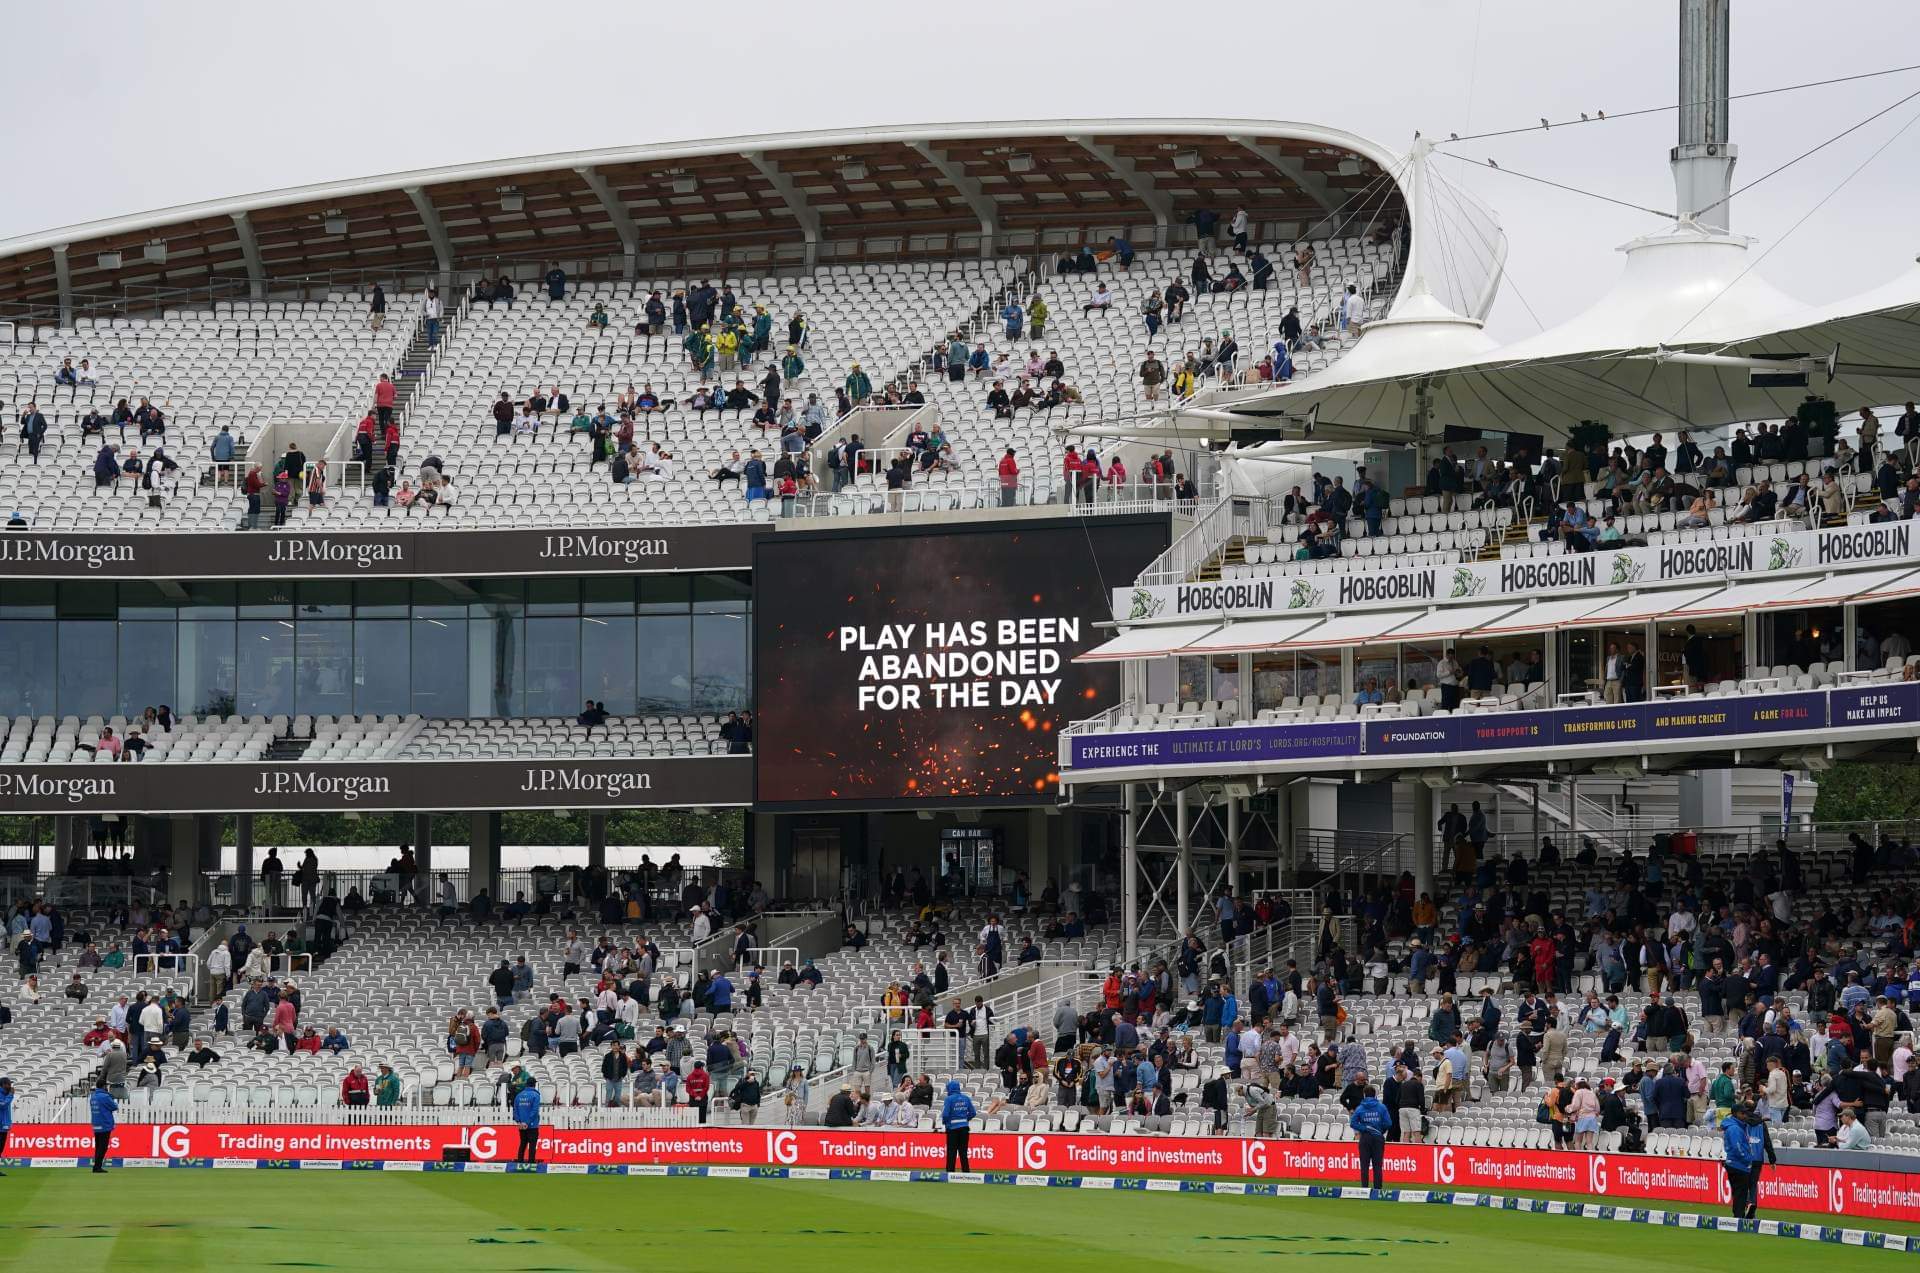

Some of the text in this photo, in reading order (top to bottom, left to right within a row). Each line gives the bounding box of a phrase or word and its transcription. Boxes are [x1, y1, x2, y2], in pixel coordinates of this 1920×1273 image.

[268, 539, 404, 568] J.P.Morgan
[540, 536, 669, 564] J.P.Morgan
[1818, 524, 1910, 564] HOBGOBLIN
[1660, 541, 1753, 579] HOBGOBLIN
[1339, 570, 1435, 604] HOBGOBLIN
[1501, 556, 1596, 593] HOBGOBLIN
[1177, 581, 1273, 614] HOBGOBLIN
[840, 617, 1080, 651] PLAY HAS BEEN
[858, 648, 1061, 682] ABANDONED
[858, 679, 1062, 711] FOR THE DAY
[1860, 695, 1888, 706] HELP US
[1563, 719, 1637, 733] TRANSFORMING LIVES
[1656, 713, 1727, 727] AND MAKING CRICKET
[1754, 708, 1808, 720] A GAME FOR ALL
[1847, 707, 1902, 720] MAKE AN IMPACT
[1391, 732, 1445, 742] FOUNDATION
[1476, 725, 1538, 738] YOUR SUPPORT IS
[1082, 745, 1139, 759] EXPERIENCE
[1141, 744, 1159, 756] THE
[1173, 741, 1214, 754] ULTIMATE
[1216, 740, 1227, 752] AT
[254, 772, 390, 800] J.P.Morgan
[522, 769, 652, 797] J.P.Morgan
[151, 1125, 190, 1158] IG
[217, 1133, 431, 1153] Trading and investments
[459, 1126, 498, 1160] IG
[553, 1138, 613, 1157] Trading
[617, 1137, 647, 1153] and
[651, 1137, 743, 1153] investments
[766, 1130, 798, 1165] IG
[819, 1140, 877, 1161] Trading
[879, 1142, 907, 1157] and
[1017, 1135, 1047, 1170] IG
[1066, 1144, 1223, 1165] Trading and investments
[1242, 1140, 1267, 1177] IG
[1283, 1151, 1417, 1172] Trading and inments
[1433, 1146, 1455, 1184] IG
[1468, 1157, 1576, 1181] Trading and investments
[1589, 1154, 1607, 1194] IG
[1618, 1166, 1709, 1190] Trading and investments
[1765, 1177, 1778, 1196] and
[1778, 1178, 1819, 1199] investments
[1828, 1169, 1844, 1213] IG
[1852, 1182, 1877, 1209] Trading
[1877, 1185, 1892, 1205] and
